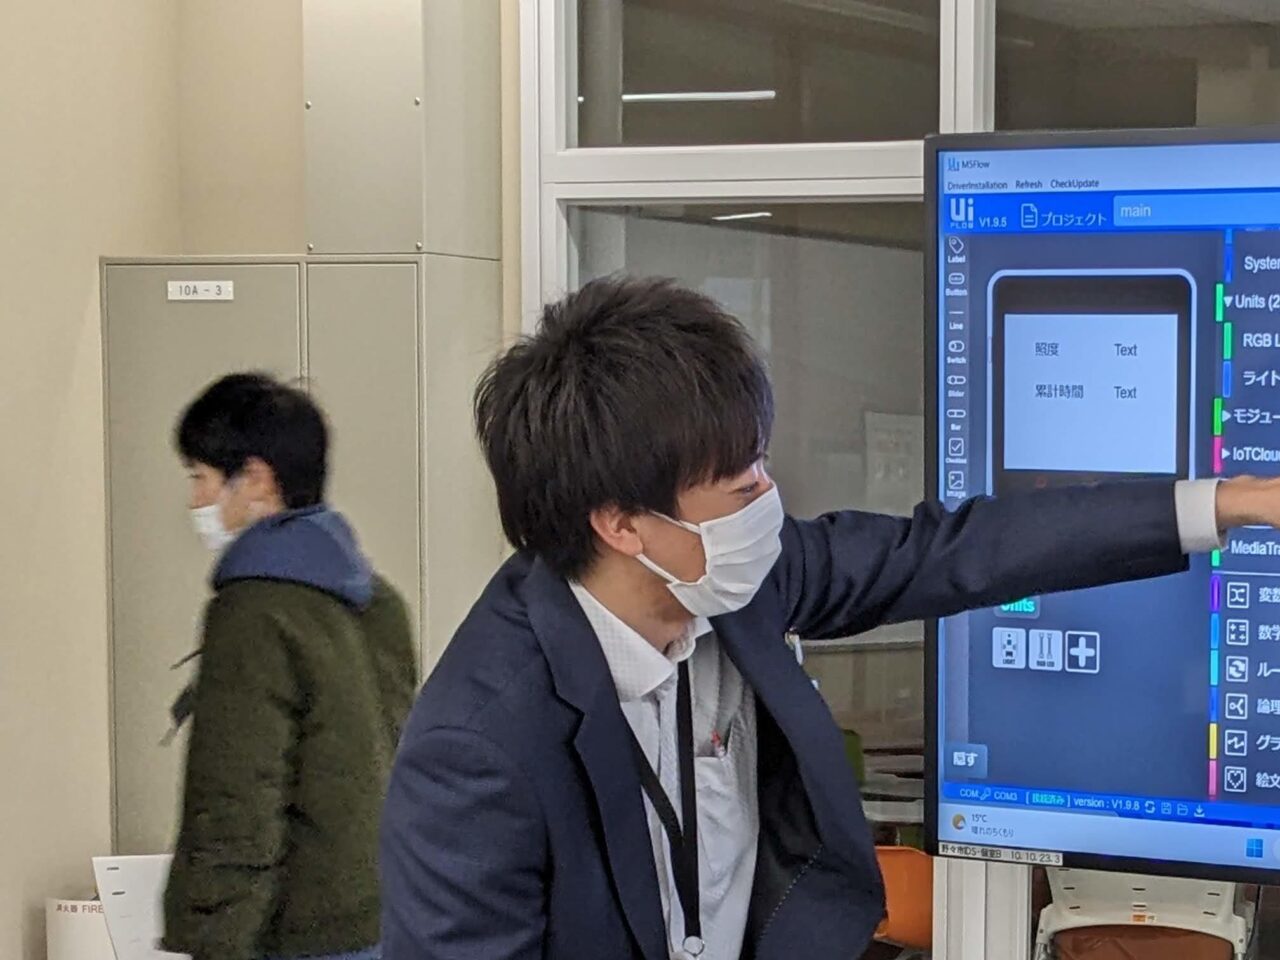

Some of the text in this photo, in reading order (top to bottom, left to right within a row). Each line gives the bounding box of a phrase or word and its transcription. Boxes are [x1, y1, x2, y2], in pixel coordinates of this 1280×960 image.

[962, 160, 990, 169] M5Flow
[947, 178, 1100, 190] DriverInstallation Refresh CheckUpdate
[1120, 205, 1151, 217] main
[979, 217, 1007, 228] V1.9.5
[1041, 211, 1107, 227] プロジェクト
[1236, 295, 1265, 309] Units
[1243, 333, 1272, 348] RGB
[1035, 342, 1060, 357] 照度
[1114, 343, 1138, 357] Text
[1035, 384, 1084, 399] 累計時間
[1114, 386, 1137, 399] Text
[953, 751, 978, 767] 隠す
[994, 791, 1017, 801] COM3
[1073, 798, 1104, 808] version
[82, 904, 104, 914] FIRE
